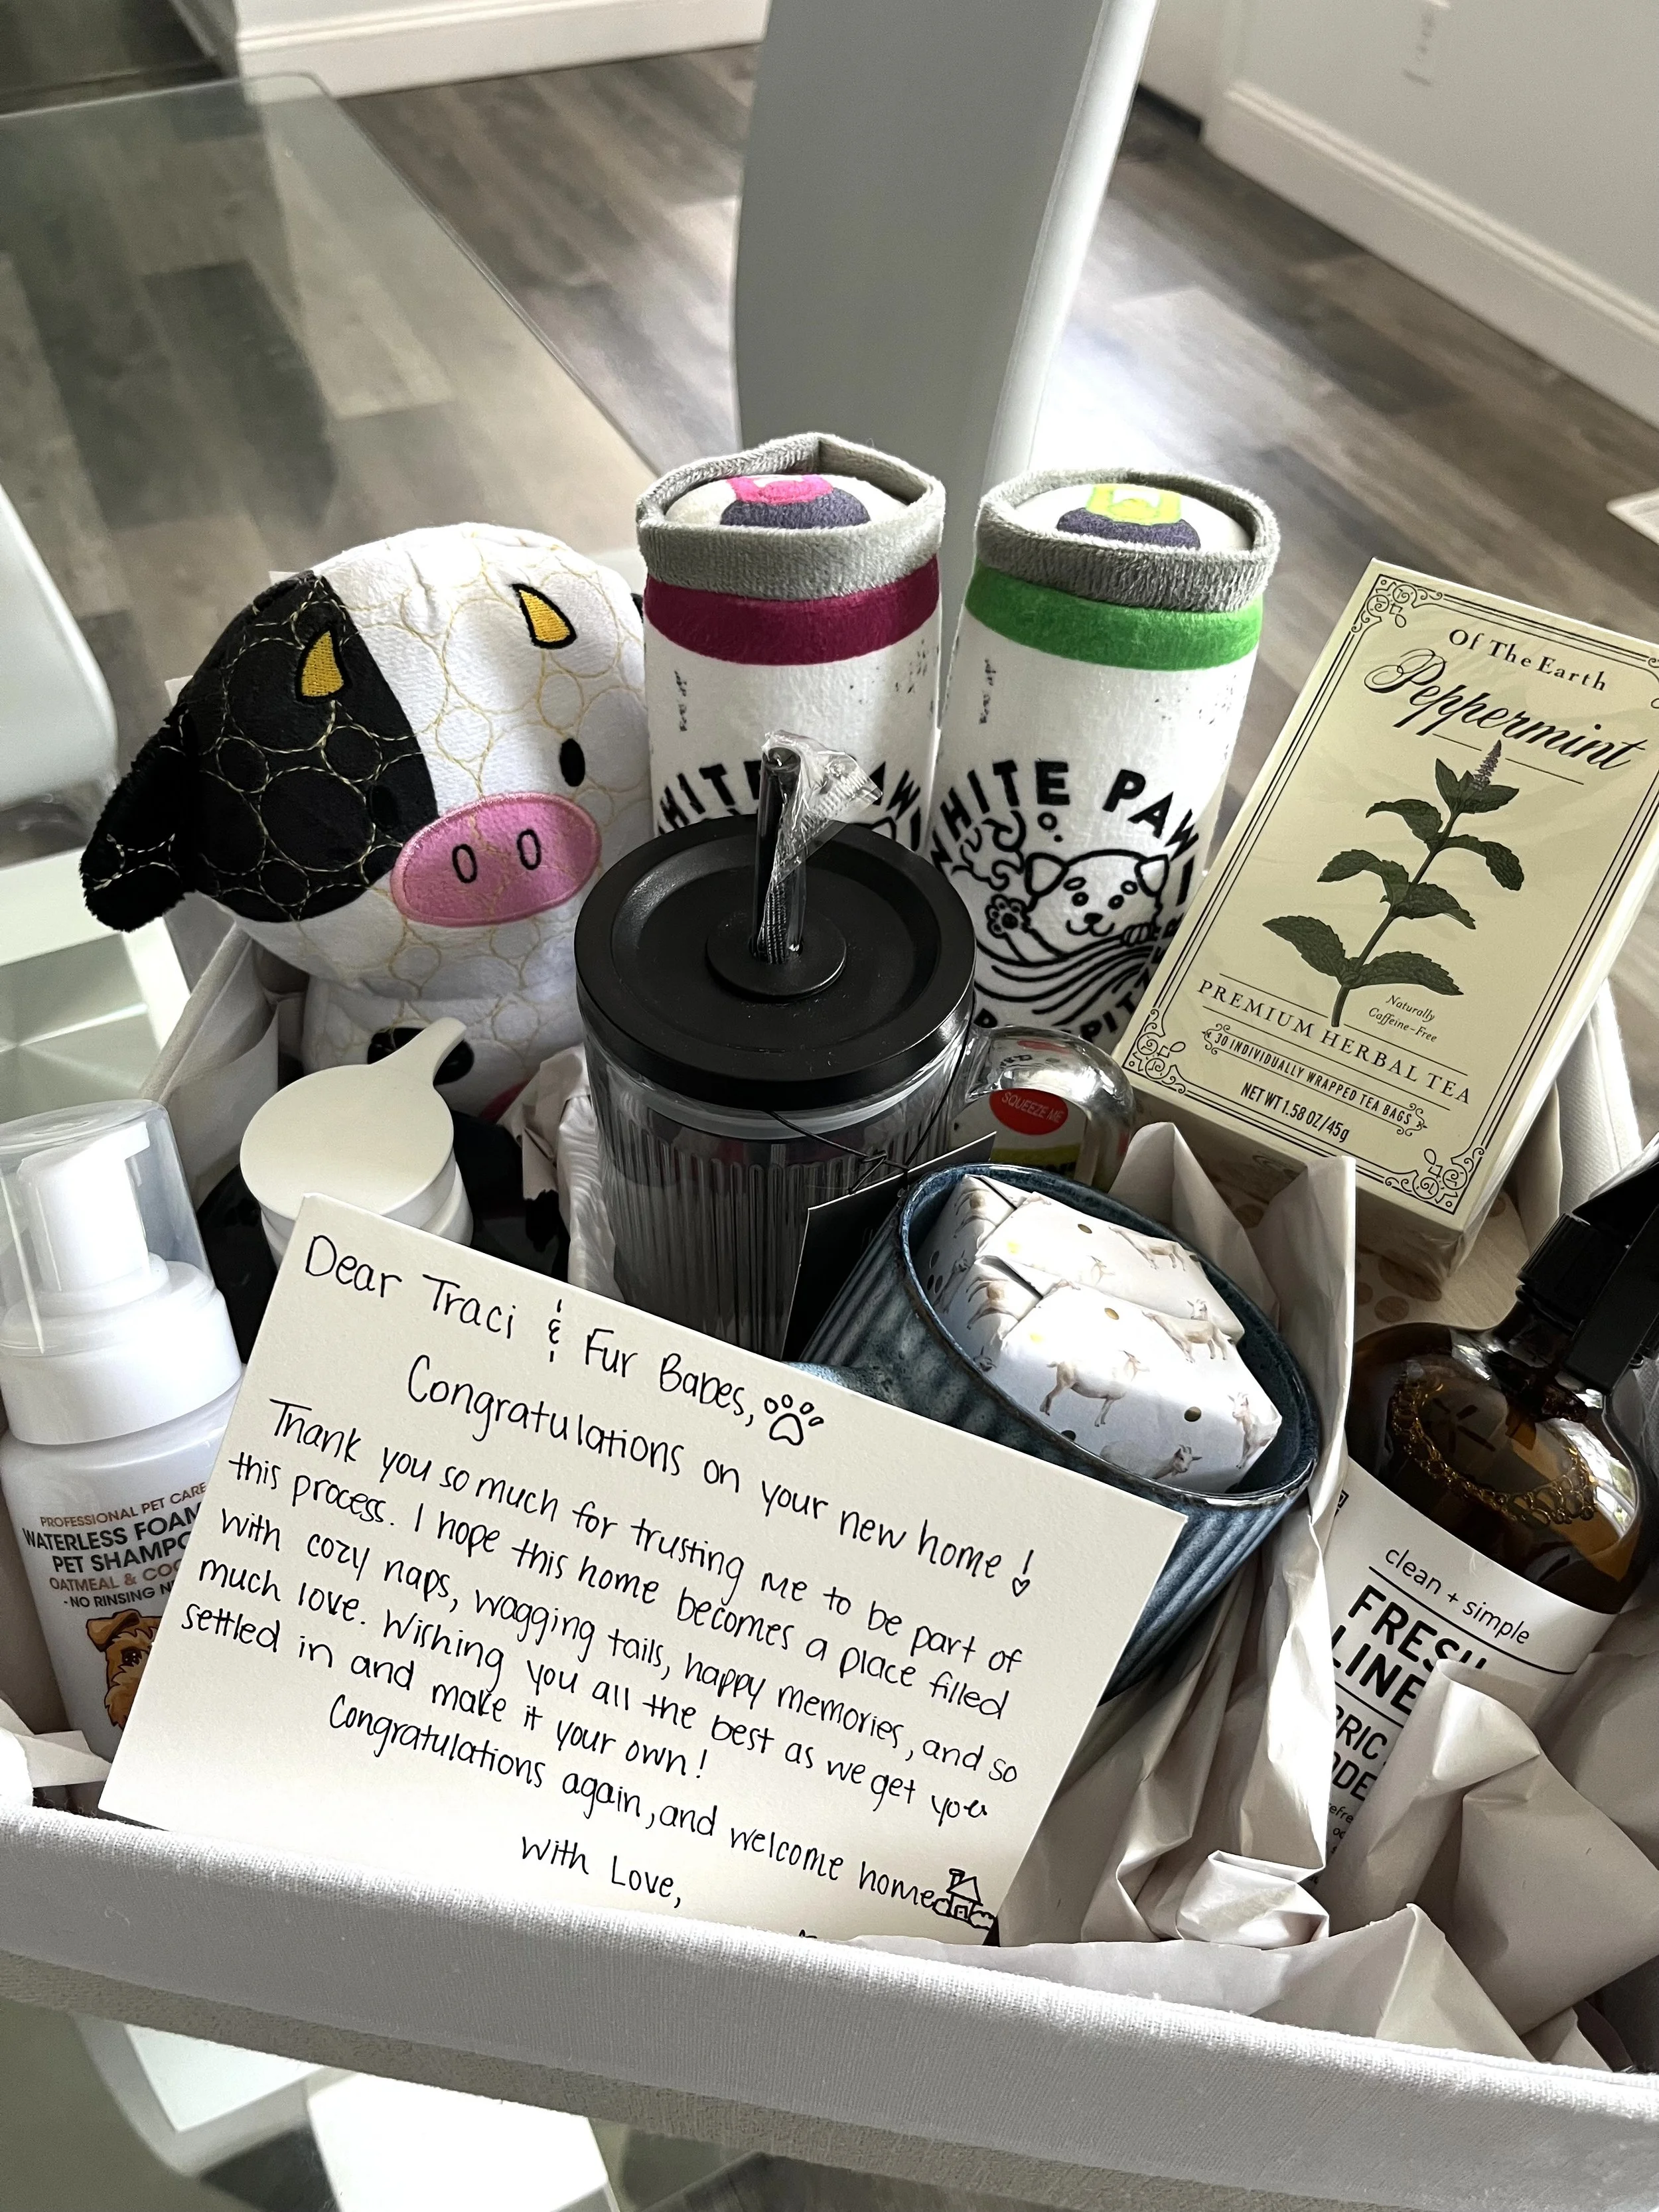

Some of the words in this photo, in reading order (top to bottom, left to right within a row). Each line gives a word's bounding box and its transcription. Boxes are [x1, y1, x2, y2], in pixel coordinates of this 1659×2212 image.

[1449, 629, 1484, 650] Of
[1488, 639, 1532, 667] The
[1536, 656, 1605, 691] Earth
[1363, 648, 1648, 771] Peppermint
[658, 760, 762, 835] HIT
[1102, 768, 1200, 862] PAW
[1196, 979, 1315, 1039] PREMIUM
[1321, 1028, 1418, 1082] HERBAL
[1426, 1072, 1469, 1104] TEA
[1368, 1005, 1437, 1042] Caffeine-Free
[1385, 994, 1435, 1023] Naturally
[1001, 1091, 1047, 1120] SQUEEZE
[1046, 1108, 1064, 1124] ME
[1214, 1033, 1229, 1047] 30
[1229, 1039, 1305, 1078] INDIVIDUALLY
[1306, 1071, 1357, 1101] WRAPPED
[1359, 1094, 1380, 1112] TEA
[1382, 1104, 1412, 1125] BAGS
[1240, 1082, 1266, 1102] NET
[1263, 1091, 1283, 1110] WT
[1281, 1100, 1307, 1121] 1.58
[305, 1234, 403, 1298] Dear
[422, 1274, 516, 1339] Traci
[548, 1299, 562, 1363] &
[585, 1328, 638, 1378] Fur
[660, 1353, 754, 1428] Babes,
[407, 1355, 682, 1477] Congratulations
[703, 1459, 739, 1493] on
[761, 1480, 829, 1520] your
[839, 1510, 907, 1549] new
[22, 1525, 128, 1551] WATERLESS
[40, 1506, 139, 1528] PROFESSIONAL
[141, 1498, 165, 1514] PET
[170, 1482, 206, 1505] CARE
[269, 1398, 362, 1463] Thank
[379, 1447, 432, 1483] you
[439, 1465, 470, 1492] so
[475, 1477, 558, 1522] much
[571, 1501, 618, 1539] for
[630, 1518, 745, 1606] trusting
[760, 1572, 808, 1601] me
[823, 1586, 851, 1615] to
[867, 1600, 902, 1637] be
[910, 1625, 976, 1663] part
[988, 1649, 1023, 1674] of
[49, 1576, 119, 1591] OATMEAL
[124, 1572, 137, 1586] &
[52, 1554, 84, 1574] PET
[91, 1530, 192, 1572] SHAMPO
[94, 1586, 156, 1607] RINSING
[228, 1451, 281, 1490] this
[291, 1474, 396, 1526] process.
[414, 1503, 424, 1532] I
[437, 1511, 500, 1558] hope
[511, 1538, 569, 1580] this
[577, 1555, 660, 1605] home
[677, 1586, 795, 1651] becomes
[806, 1638, 828, 1661] a
[839, 1647, 916, 1687] place
[928, 1670, 1009, 1720] filled
[1385, 1549, 1441, 1595] clean
[1447, 1592, 1459, 1603] +
[1462, 1601, 1530, 1645] simple
[222, 1508, 280, 1552] with
[307, 1533, 370, 1582] cozy
[384, 1560, 459, 1613] naps,
[475, 1589, 595, 1663] wagging
[607, 1628, 670, 1680] tails,
[685, 1652, 766, 1710] happy
[777, 1684, 913, 1761] memories,
[922, 1739, 985, 1771] and
[988, 1758, 1017, 1783] so
[1331, 1625, 1426, 1716] LINE
[1348, 1584, 1487, 1673] FRES
[180, 1603, 281, 1653] settled
[299, 1635, 333, 1668] in
[350, 1655, 415, 1691] and
[431, 1683, 507, 1724] make
[523, 1706, 543, 1731] it
[557, 1720, 616, 1755] your
[625, 1739, 707, 1779] own!
[198, 1559, 281, 1602] much
[298, 1582, 366, 1625] love.
[384, 1609, 504, 1692] Wishing
[526, 1660, 579, 1696] you
[591, 1681, 629, 1711] all
[642, 1694, 697, 1730] the
[711, 1714, 775, 1754] best
[784, 1742, 814, 1769] as
[827, 1760, 866, 1785] we
[870, 1774, 916, 1812] get
[329, 1692, 546, 1789] Congratulations
[731, 1827, 844, 1881] welcome
[858, 1860, 936, 1909] home
[611, 1855, 681, 1909] Love,
